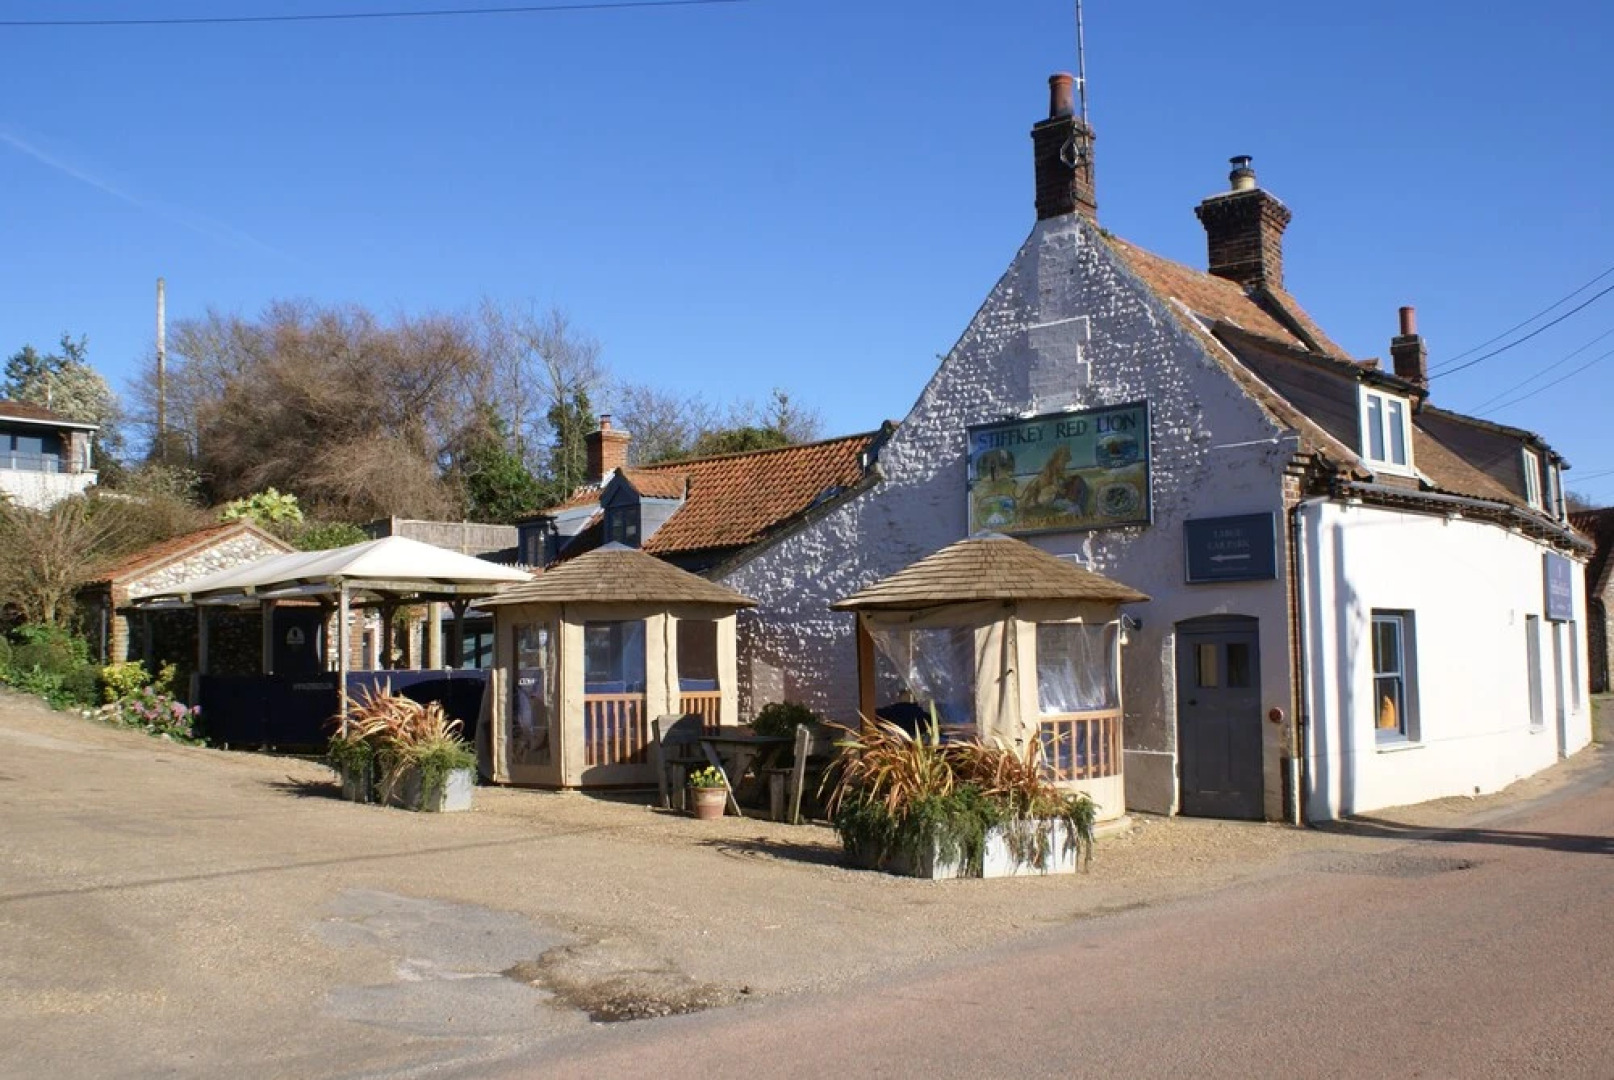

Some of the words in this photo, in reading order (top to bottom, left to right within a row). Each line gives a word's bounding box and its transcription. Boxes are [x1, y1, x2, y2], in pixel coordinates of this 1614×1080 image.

[978, 424, 1046, 448] STIFFKEY
[1055, 419, 1087, 439] RED
[1096, 412, 1136, 434] LION
